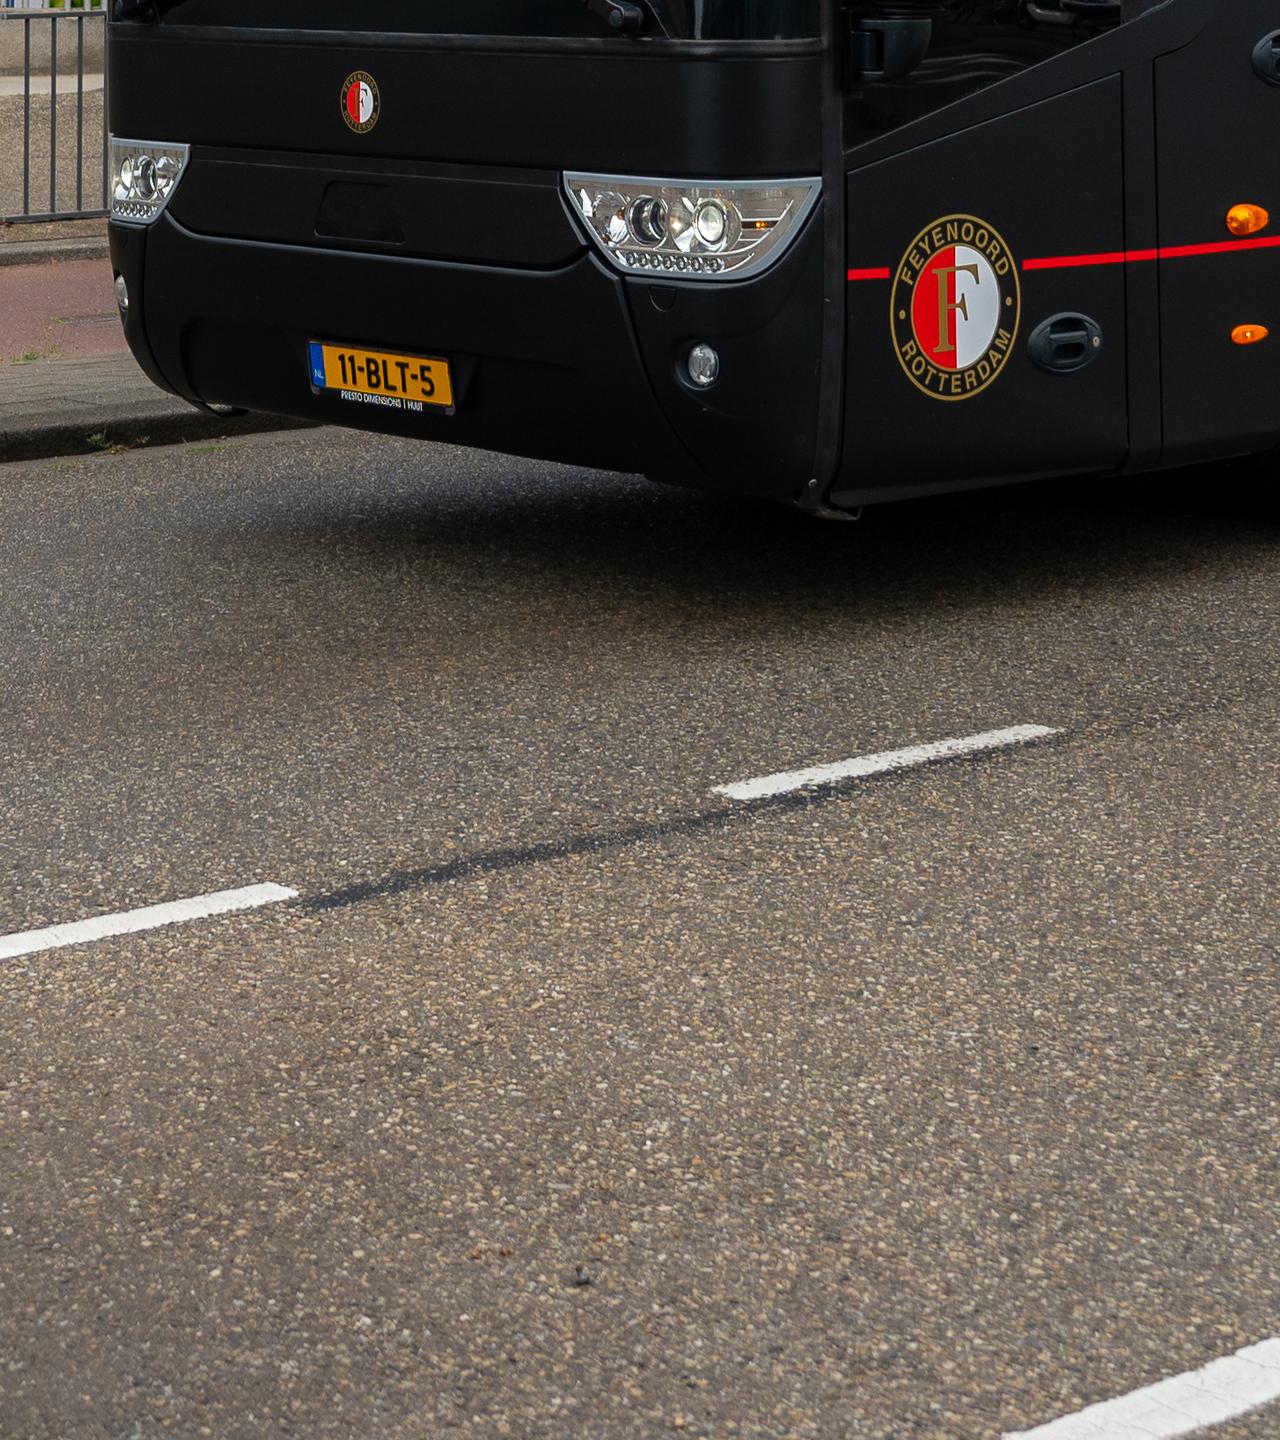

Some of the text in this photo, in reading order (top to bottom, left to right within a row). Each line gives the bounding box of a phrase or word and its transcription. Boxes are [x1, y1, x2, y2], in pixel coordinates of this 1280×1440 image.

[901, 222, 1009, 286] FEYENOORD
[931, 264, 980, 353] F
[314, 353, 435, 397] NL 11-BLT-5
[902, 328, 1010, 393] ROTTERDAM
[340, 389, 363, 403] PRESTO
[363, 393, 402, 409] DIMENSIONS
